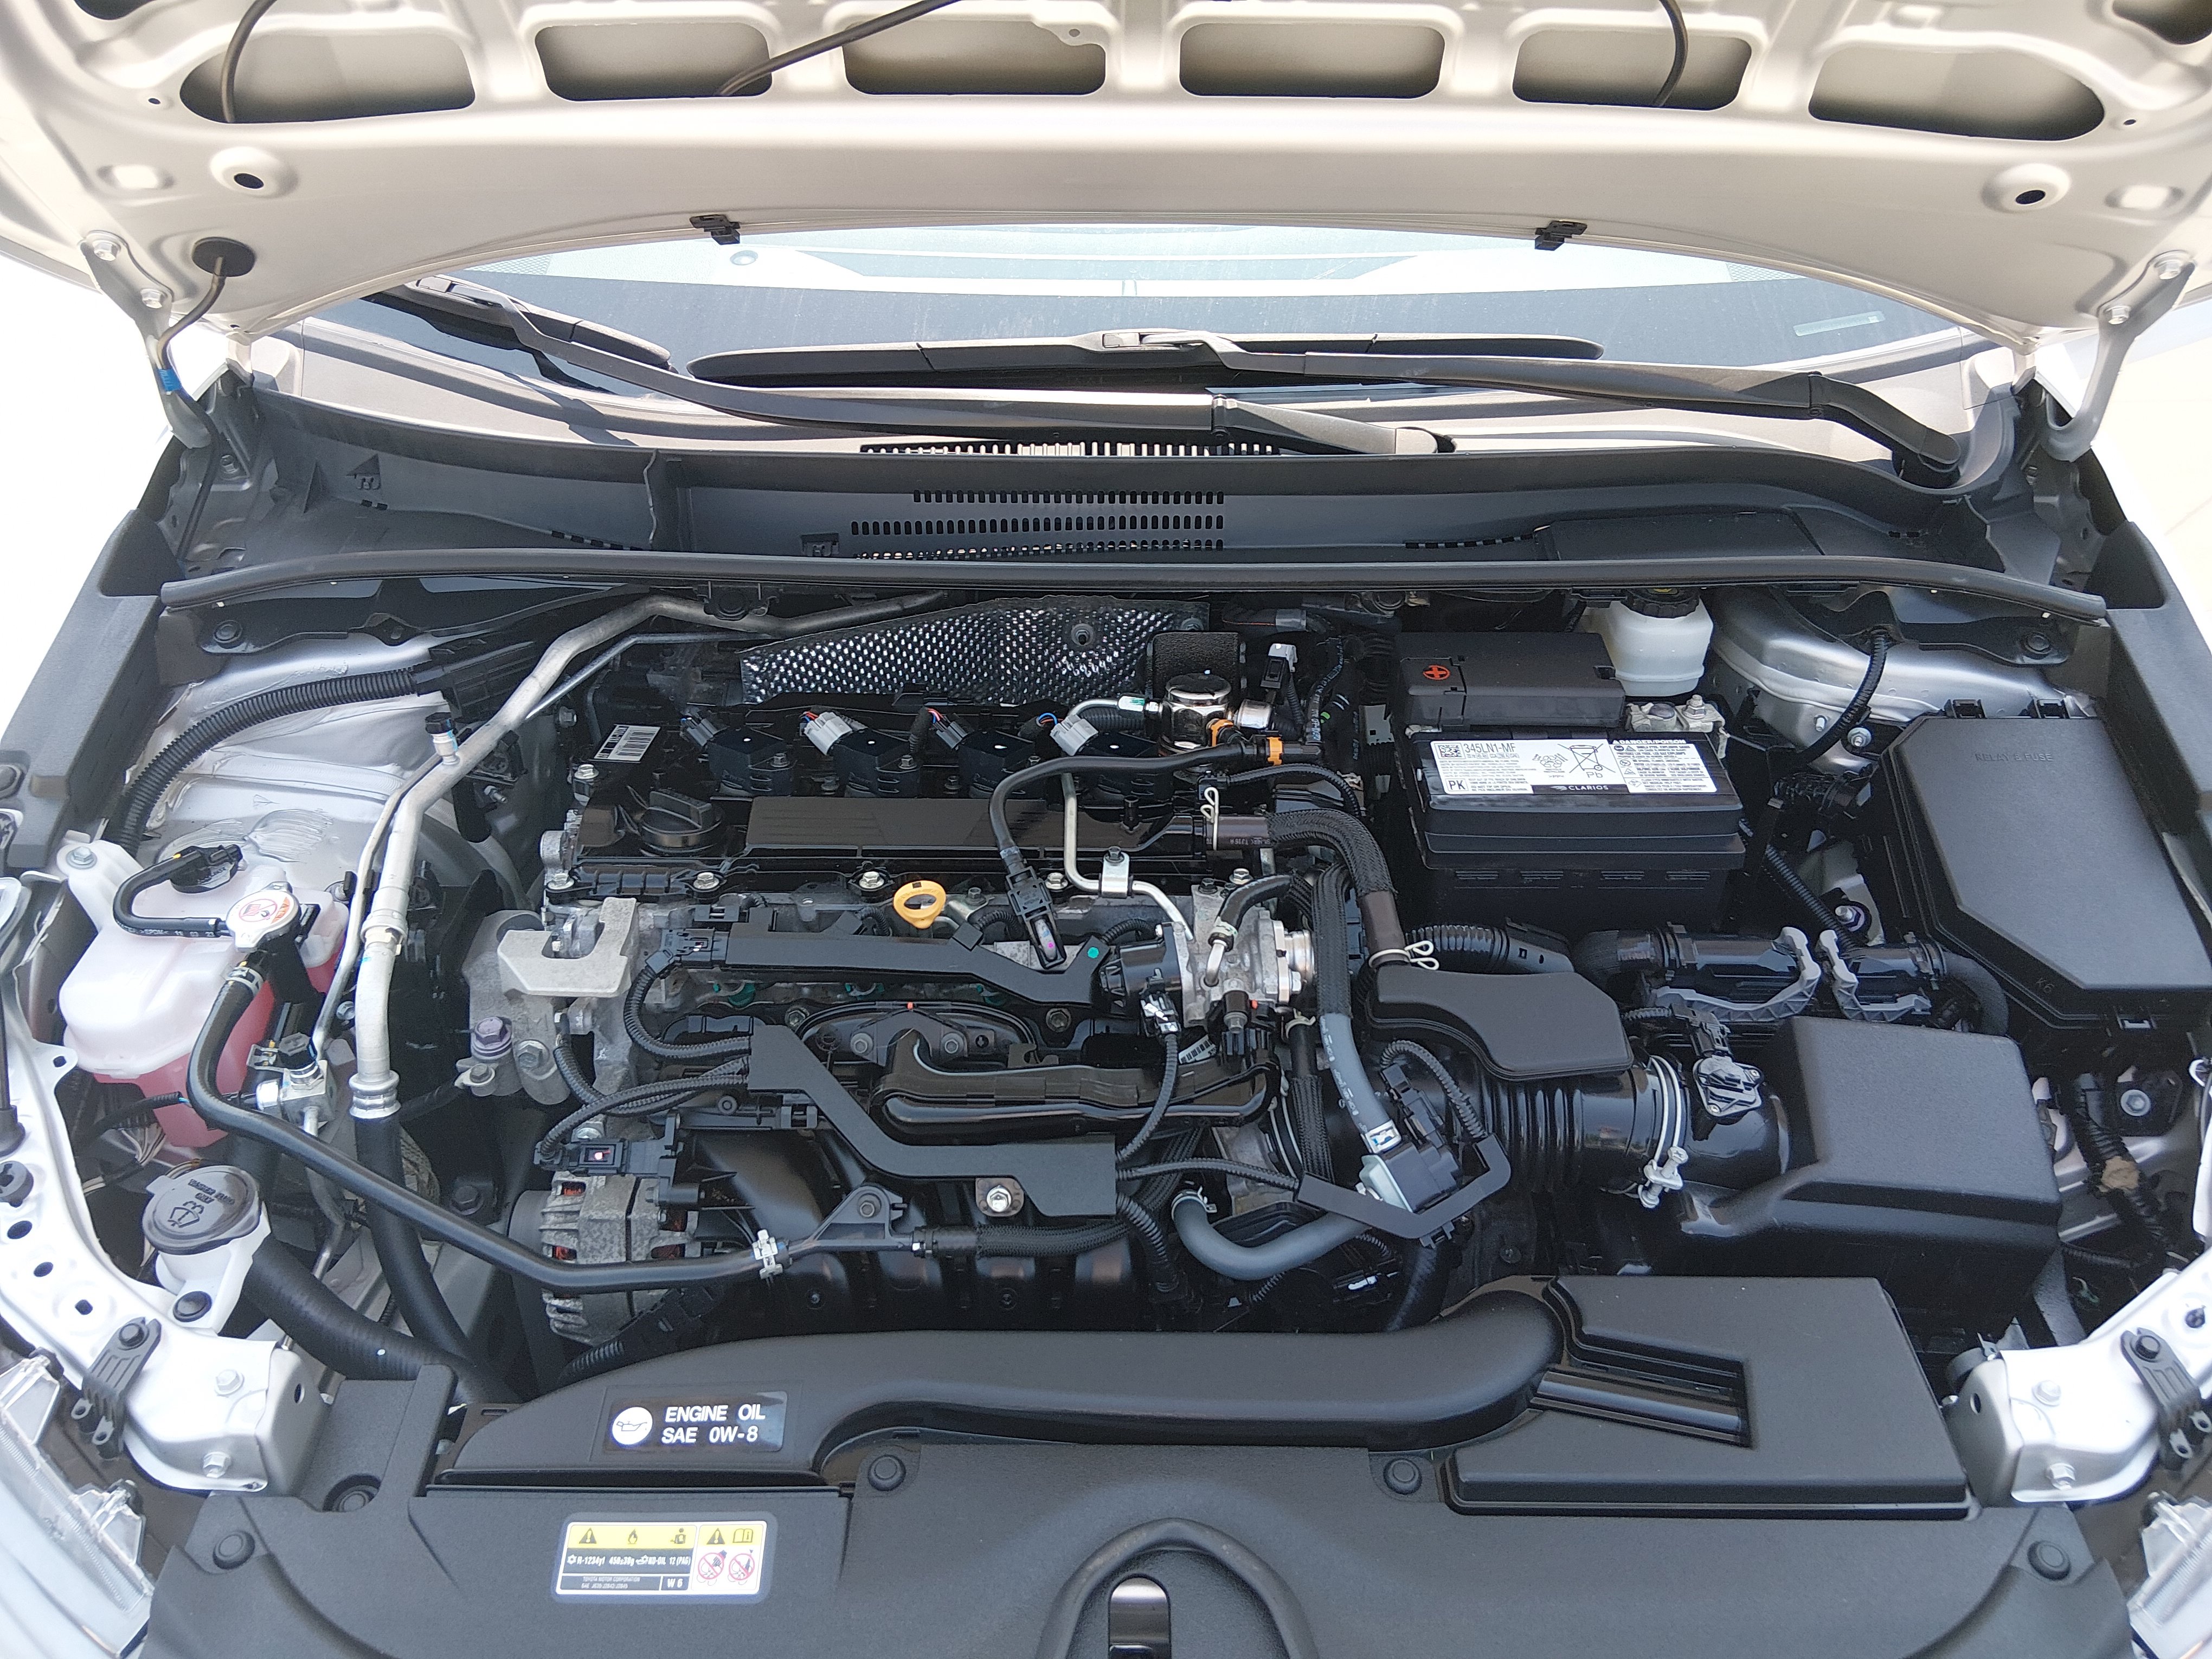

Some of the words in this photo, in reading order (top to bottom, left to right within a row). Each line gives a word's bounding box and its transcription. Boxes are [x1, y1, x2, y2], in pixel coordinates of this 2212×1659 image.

[1463, 743, 1516, 753] 345LN1-MF
[1975, 753, 2009, 762] RELAY
[2024, 753, 2054, 762] FUSE
[1448, 780, 1466, 790] PK
[665, 1405, 729, 1423] ENGINE
[738, 1404, 766, 1420] OIL
[661, 1426, 698, 1444] SAE
[709, 1425, 758, 1443] 0W-8
[667, 1578, 676, 1588] W
[677, 1578, 683, 1587] 6
